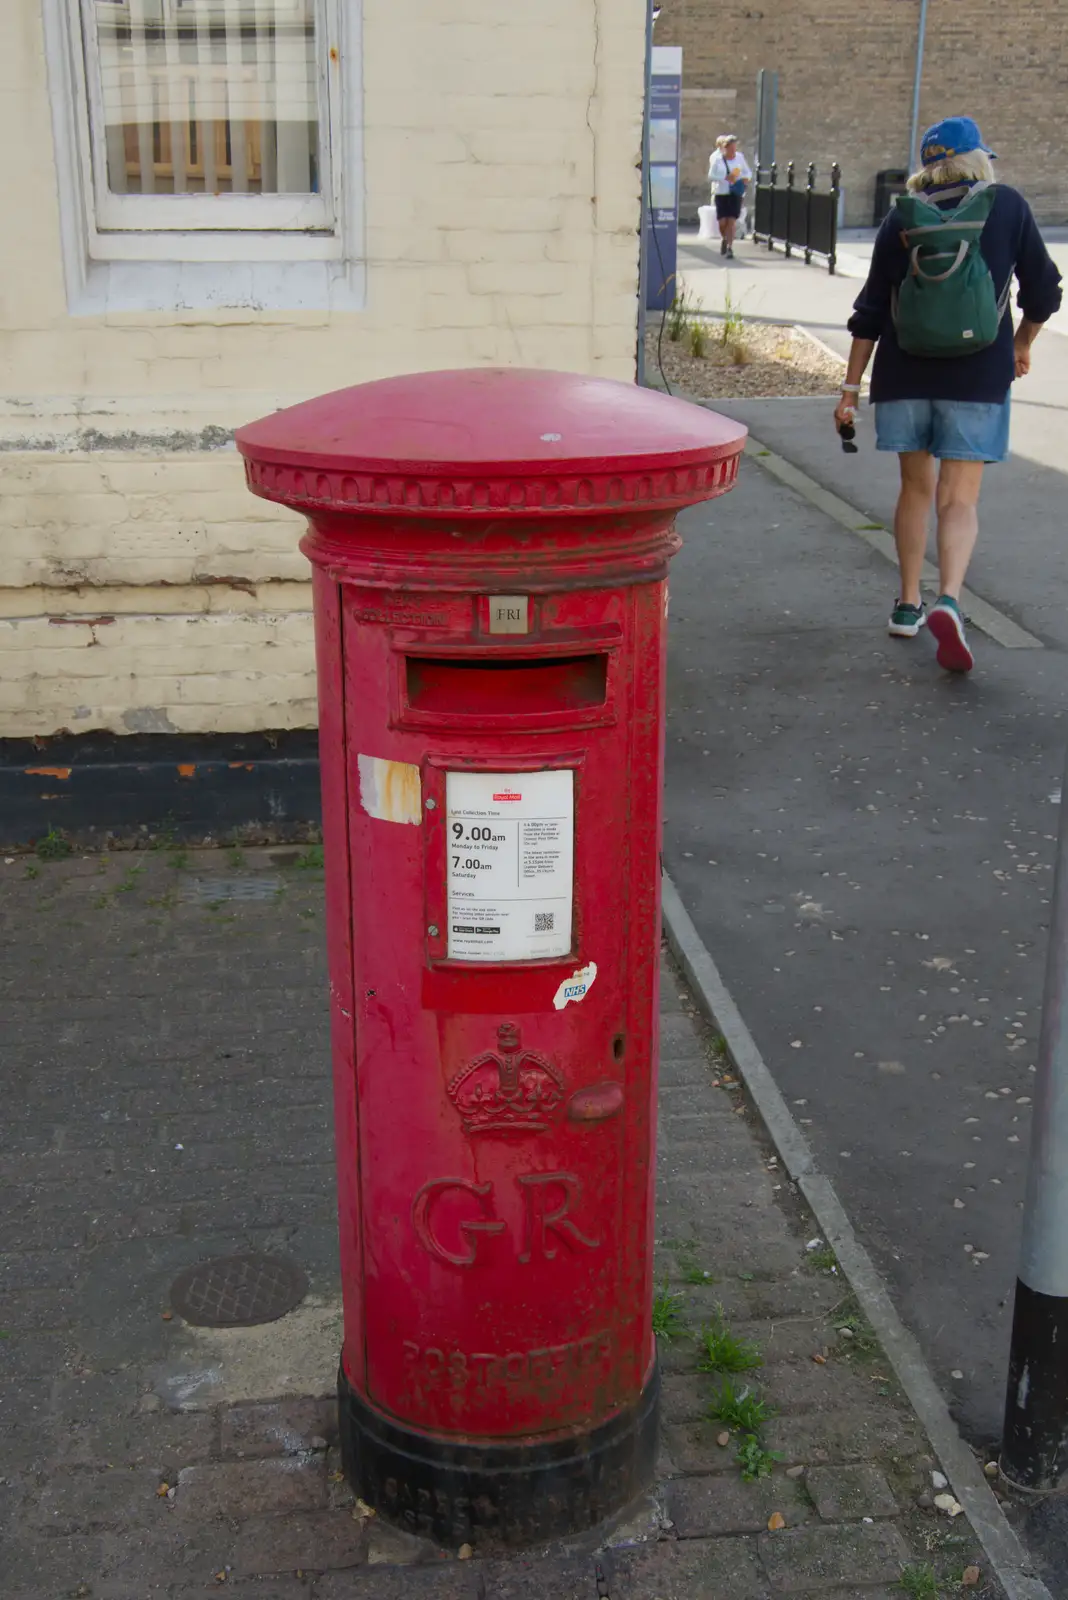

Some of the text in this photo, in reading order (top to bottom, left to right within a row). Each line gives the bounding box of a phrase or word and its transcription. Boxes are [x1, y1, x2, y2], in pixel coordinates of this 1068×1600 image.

[497, 608, 521, 621] FRI
[452, 822, 506, 842] 9.00am
[451, 843, 473, 851] Monday
[481, 844, 499, 852] Friday
[452, 855, 492, 870] 7.00am
[451, 871, 476, 879] Saturday
[452, 890, 475, 898] Services
[564, 984, 586, 998] NHS
